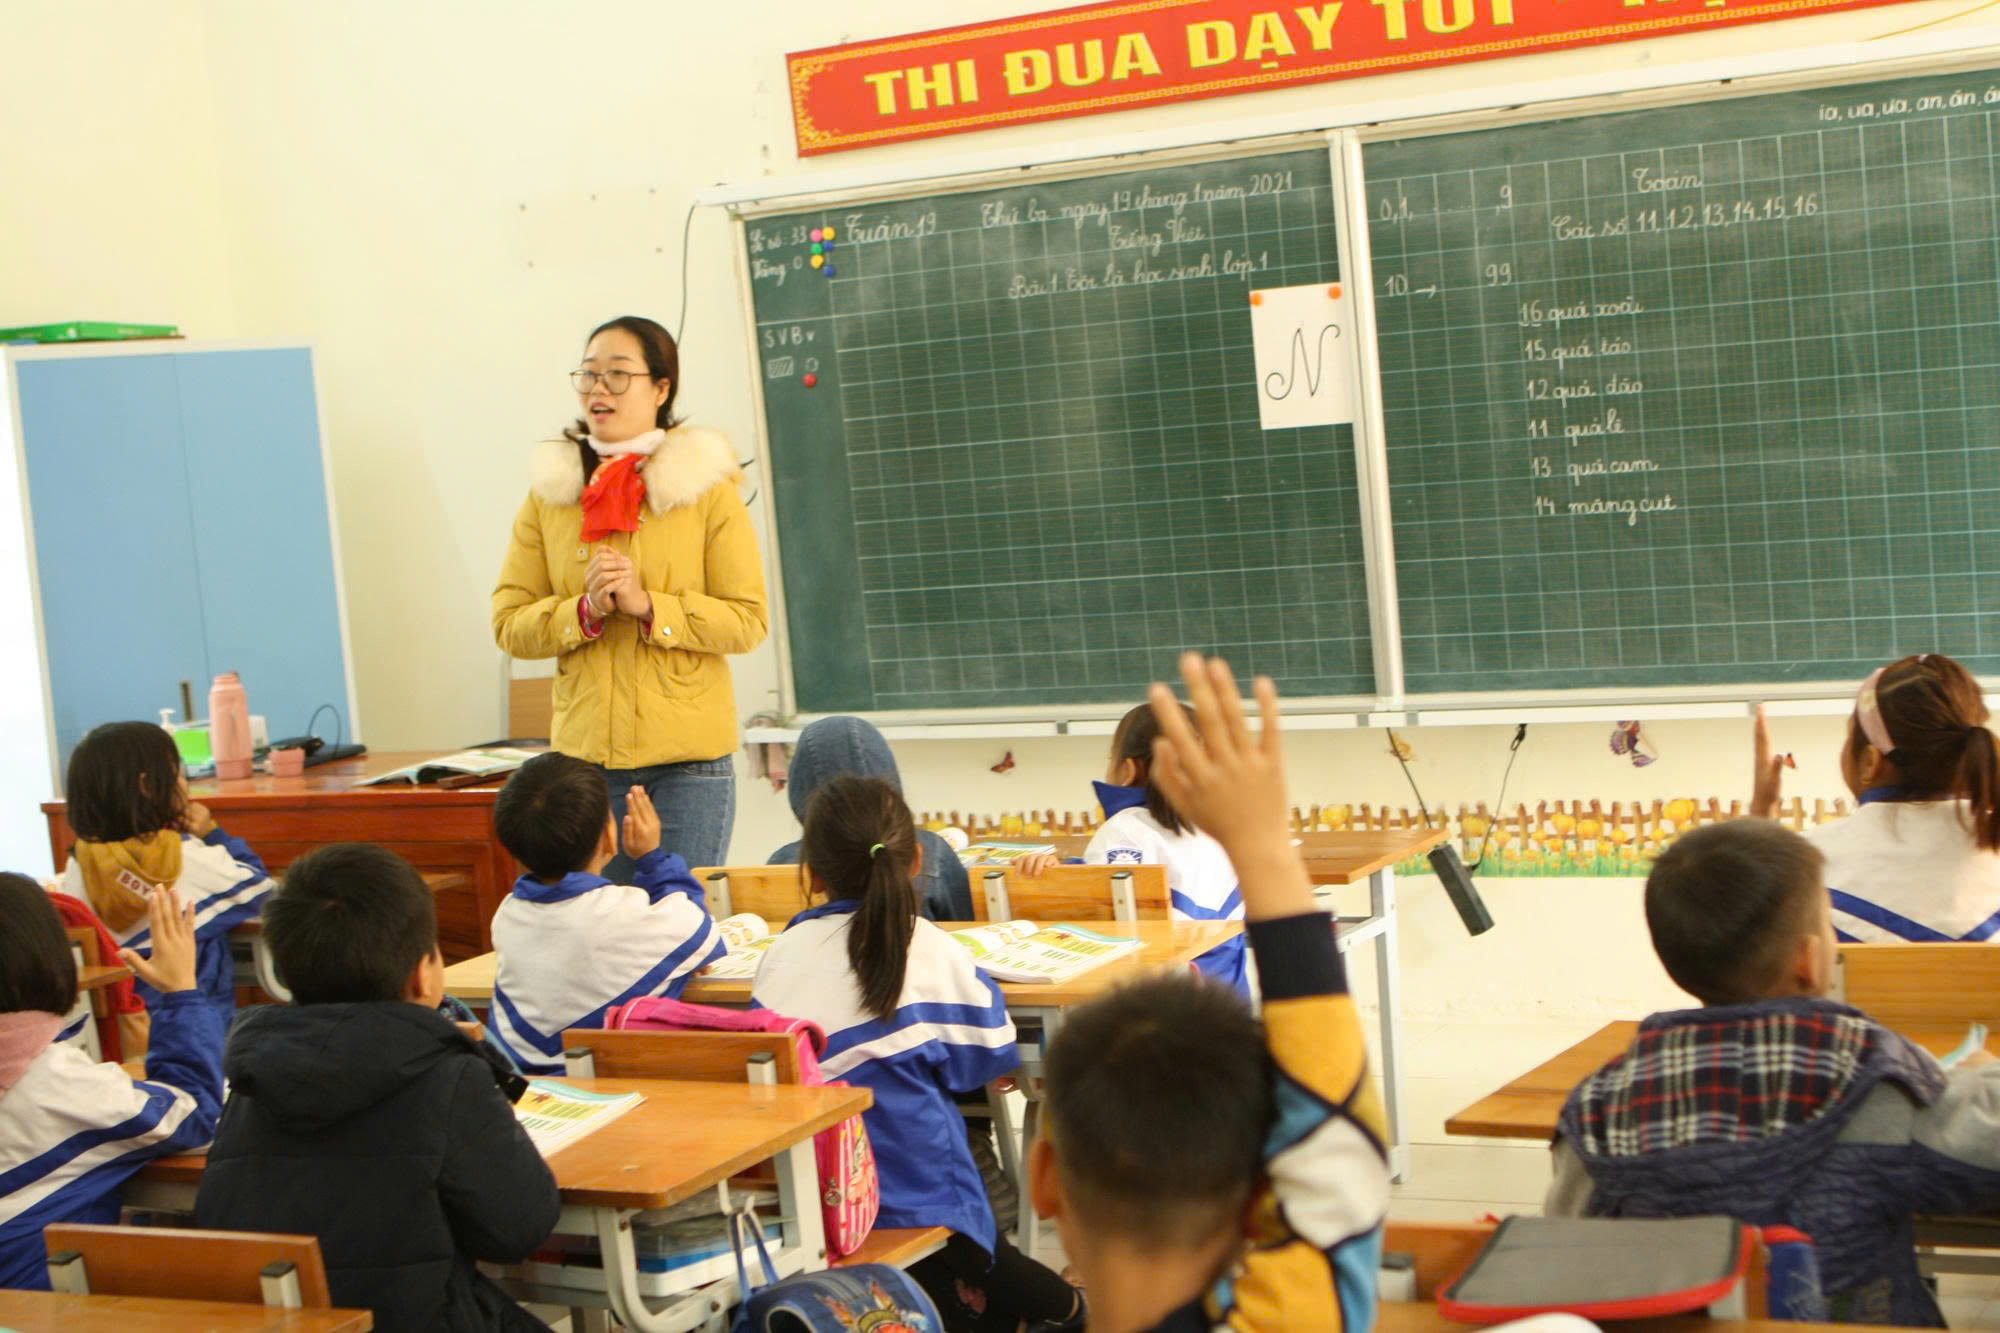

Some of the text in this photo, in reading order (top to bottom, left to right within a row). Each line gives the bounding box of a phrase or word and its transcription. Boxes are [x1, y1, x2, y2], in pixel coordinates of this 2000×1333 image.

[864, 58, 980, 115] THI
[1003, 32, 1162, 97] ĐUA
[1186, 2, 1344, 69] DẠY
[1249, 170, 1293, 196] 2021
[1633, 168, 1702, 193] Toán
[917, 212, 937, 237] 19
[1552, 216, 1595, 241] Các
[1259, 250, 1268, 271] 1
[1385, 263, 1512, 297] 10 99
[1519, 301, 1542, 322] 16
[1524, 339, 1546, 361] 15
[1264, 323, 1342, 402] N
[1527, 379, 1548, 401] 12
[1528, 419, 1548, 439] 11
[1532, 456, 1551, 478] 13
[1610, 459, 1659, 473] cam
[1535, 496, 1556, 516] 14
